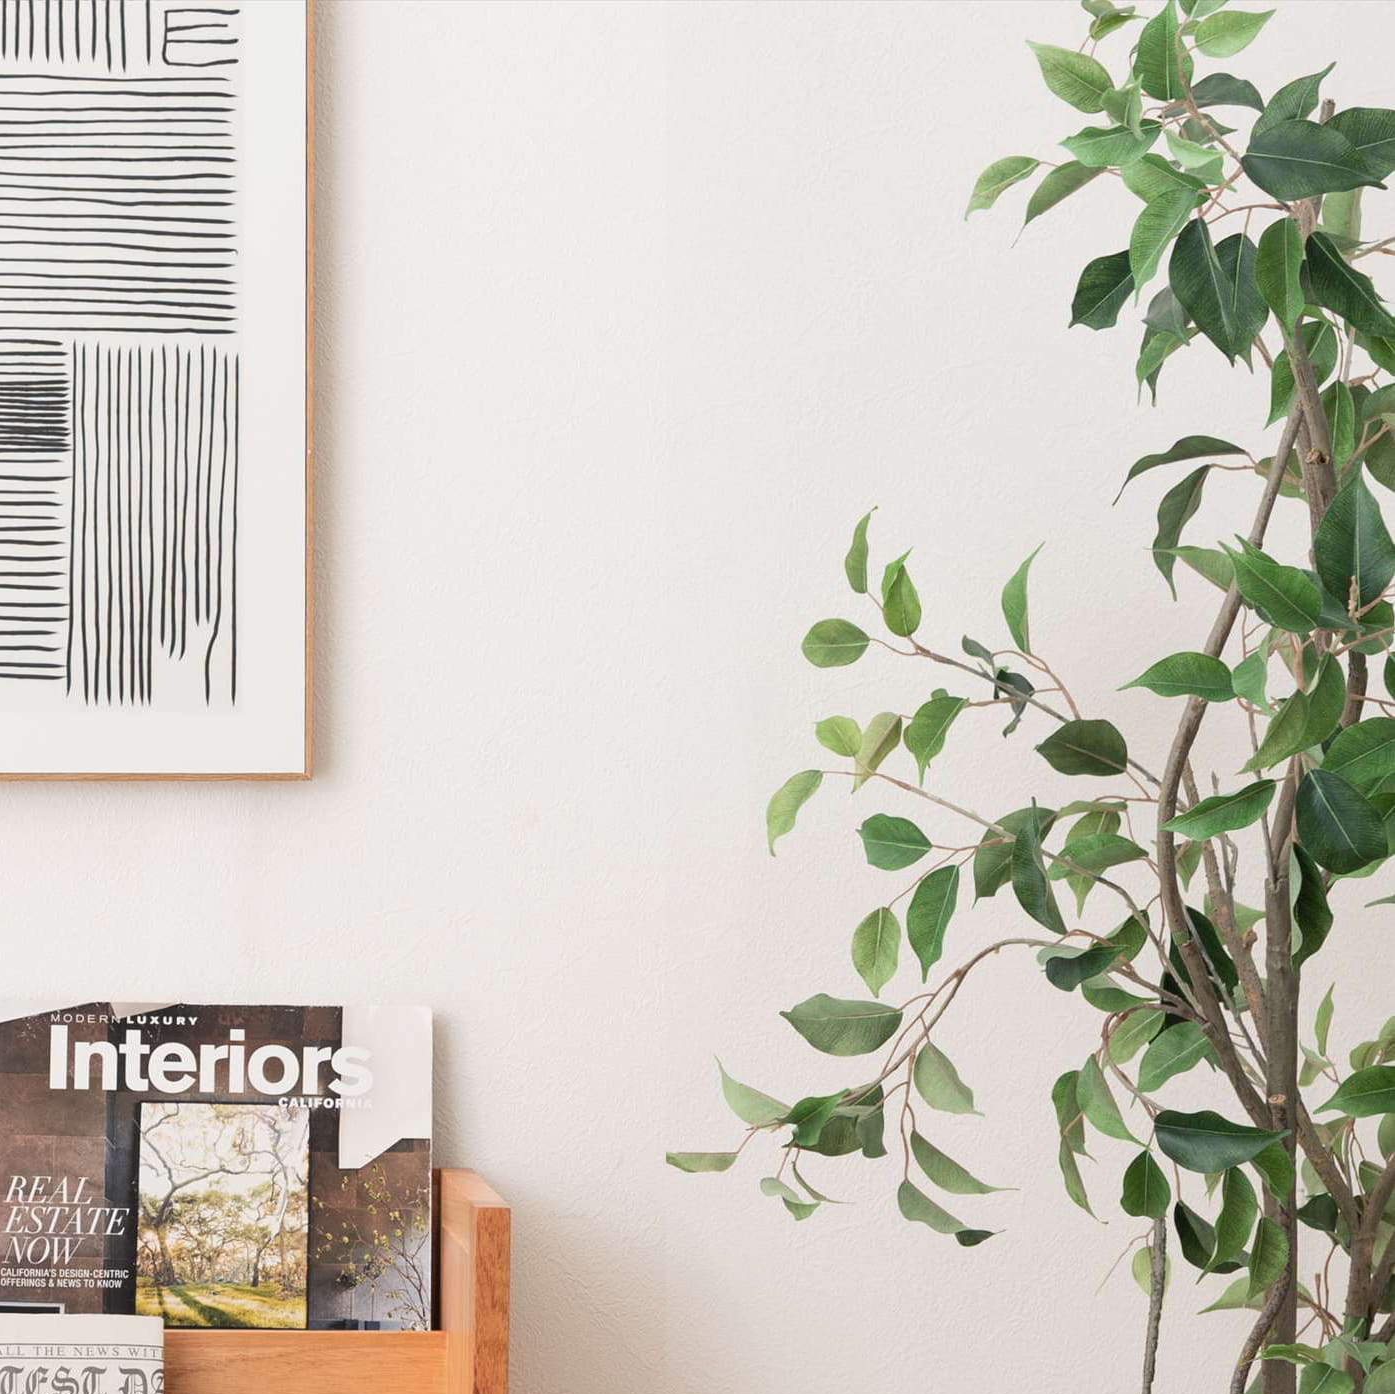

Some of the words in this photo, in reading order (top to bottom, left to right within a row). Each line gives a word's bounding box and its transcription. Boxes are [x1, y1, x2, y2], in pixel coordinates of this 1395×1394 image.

[50, 1013, 121, 1024] MODERN
[126, 1015, 198, 1026] LUXURY
[49, 1025, 374, 1096] Interiors
[278, 1097, 372, 1109] CALIFORNIA
[3, 1175, 92, 1205] REAL
[3, 1207, 130, 1236] ESTATE
[3, 1237, 86, 1265] NOW
[0, 1268, 57, 1278] CALIFORNIA'S
[0, 1278, 46, 1288] OFFERINGS
[48, 1279, 55, 1288] &
[57, 1279, 82, 1288] NEWS
[84, 1279, 95, 1288] TO
[96, 1279, 123, 1289] KNOW
[32, 1346, 67, 1356] THE
[72, 1347, 120, 1357] NEWS
